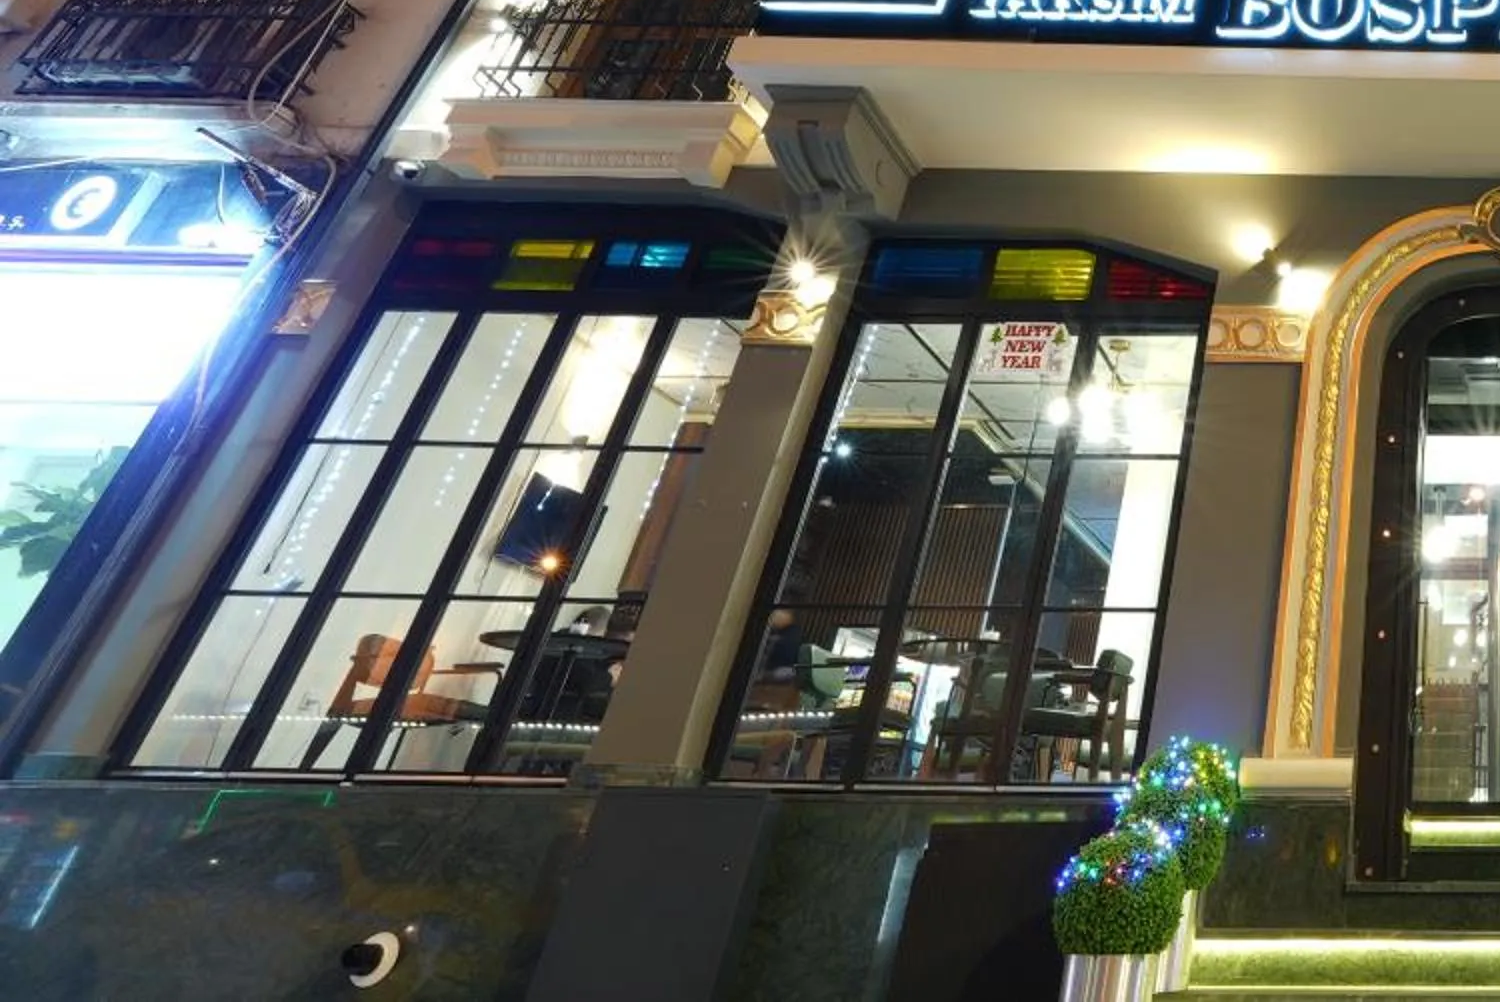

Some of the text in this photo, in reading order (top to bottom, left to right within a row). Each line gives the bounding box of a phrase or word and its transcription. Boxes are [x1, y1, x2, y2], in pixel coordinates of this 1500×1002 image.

[1005, 325, 1056, 336] HAPPY
[1003, 340, 1047, 352] NEW
[1000, 355, 1041, 369] YEAR
